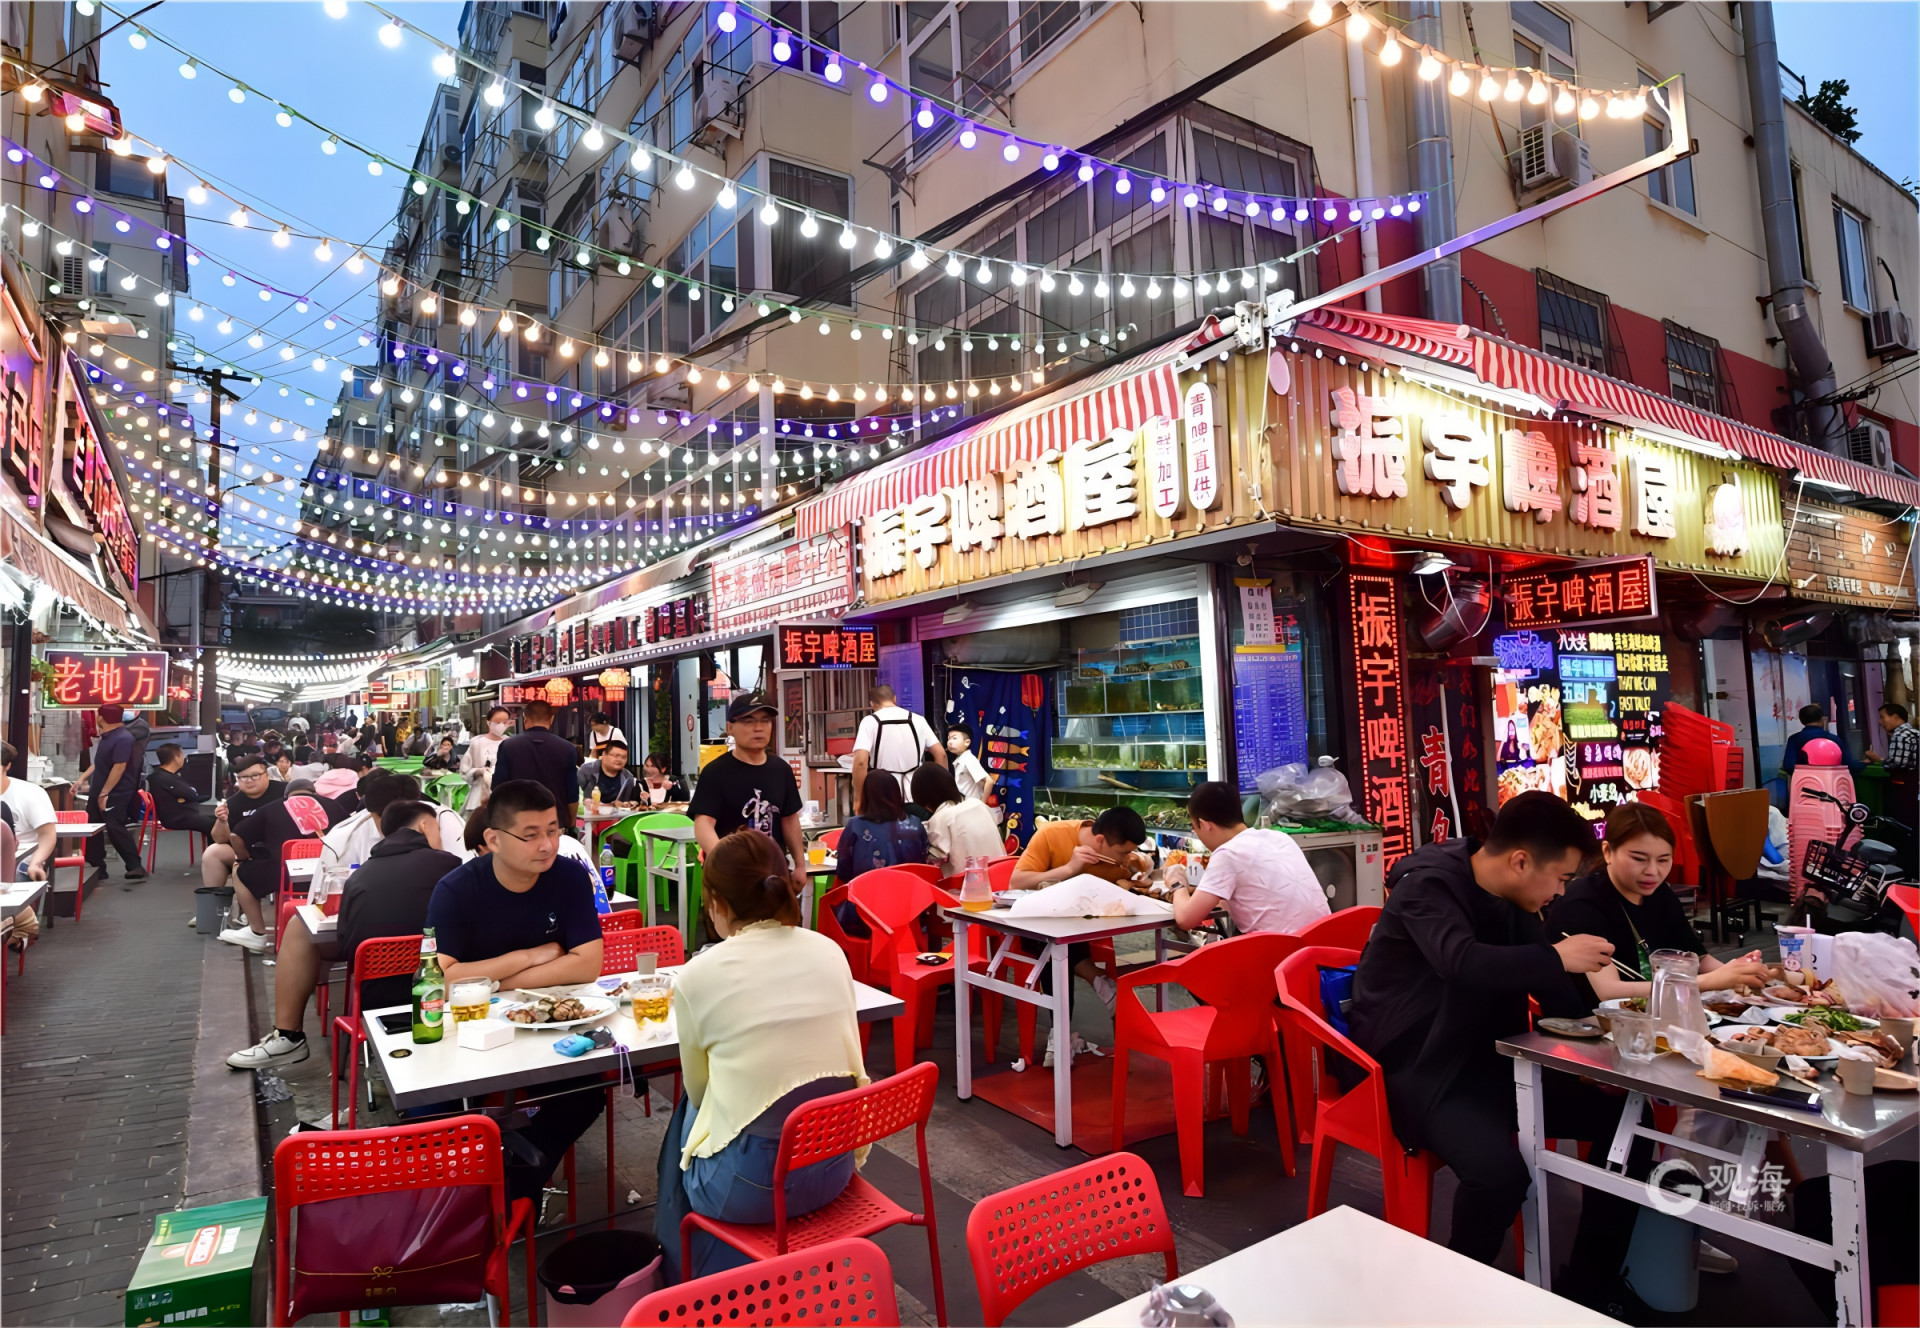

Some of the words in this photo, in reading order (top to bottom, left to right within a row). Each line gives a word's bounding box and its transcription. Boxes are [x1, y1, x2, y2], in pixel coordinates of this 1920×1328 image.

[1331, 386, 1676, 539] 振宇啤酒屋
[860, 427, 1142, 581] 振宇啤酒屋
[1509, 569, 1644, 621] 振宇啤酒屋
[784, 629, 876, 664] 振宇啤酒屋
[52, 656, 161, 703] 老地方
